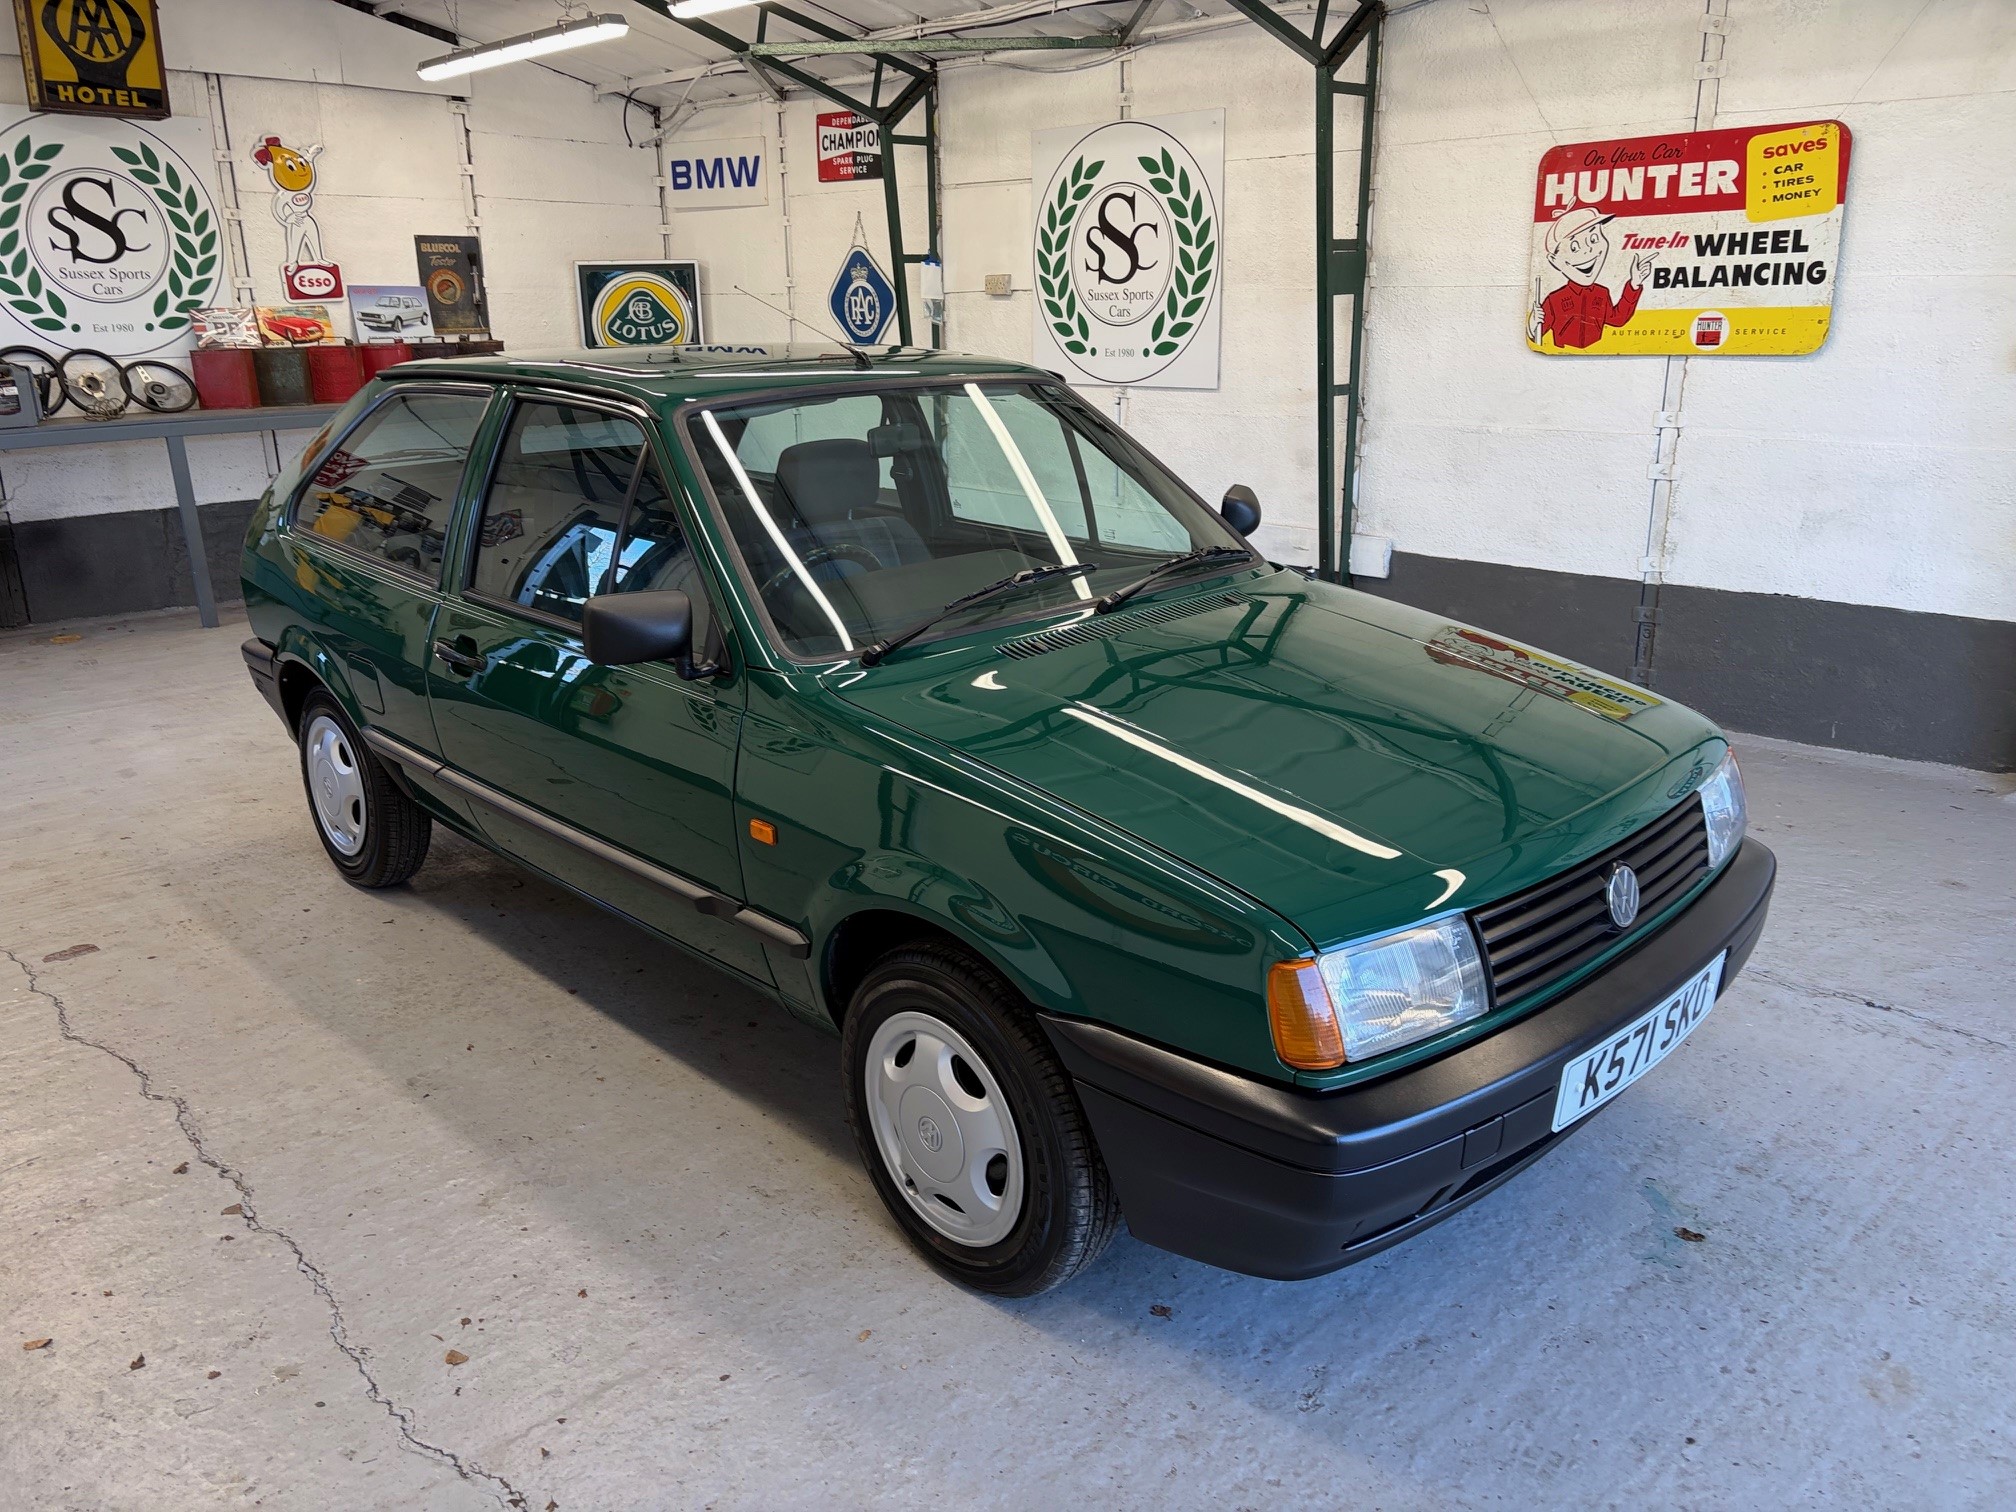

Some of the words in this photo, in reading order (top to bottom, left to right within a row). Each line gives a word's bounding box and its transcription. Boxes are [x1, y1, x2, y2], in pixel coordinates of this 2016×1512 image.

[57, 84, 147, 108] HOTEL
[1584, 149, 1608, 166] On
[1610, 148, 1646, 168] Your
[1650, 143, 1683, 160] Car
[1763, 136, 1828, 160] saves
[832, 156, 853, 166] SPARK
[856, 155, 874, 164] PLUG
[1773, 162, 1804, 174] CAR
[671, 155, 760, 190] BMW
[839, 165, 867, 175] SERVICE
[1543, 159, 1740, 207] HUNTER
[1773, 175, 1815, 189] TIRES
[1772, 187, 1823, 203] MONEY
[1621, 231, 1690, 251] Tune-In
[1694, 228, 1809, 257] WHEEL
[59, 267, 105, 280] Sussex
[109, 267, 151, 283] Sports
[297, 275, 332, 288] Esso
[1652, 261, 1827, 290] BALANCING
[93, 282, 123, 295] Cars
[1088, 288, 1119, 301] Sussex
[1123, 288, 1154, 303] Sports
[849, 287, 875, 325] RAC
[1109, 304, 1131, 318] Cars
[92, 323, 108, 333] Est
[111, 323, 134, 333] 1980
[611, 318, 676, 341] LOTUS
[1612, 329, 1685, 337] AUTHORIZED
[1735, 327, 1787, 336] SERVICE
[1696, 320, 1723, 331] HUNTER
[1104, 347, 1116, 358] Est
[1117, 347, 1135, 358] 1980
[1579, 1014, 1659, 1108] K571
